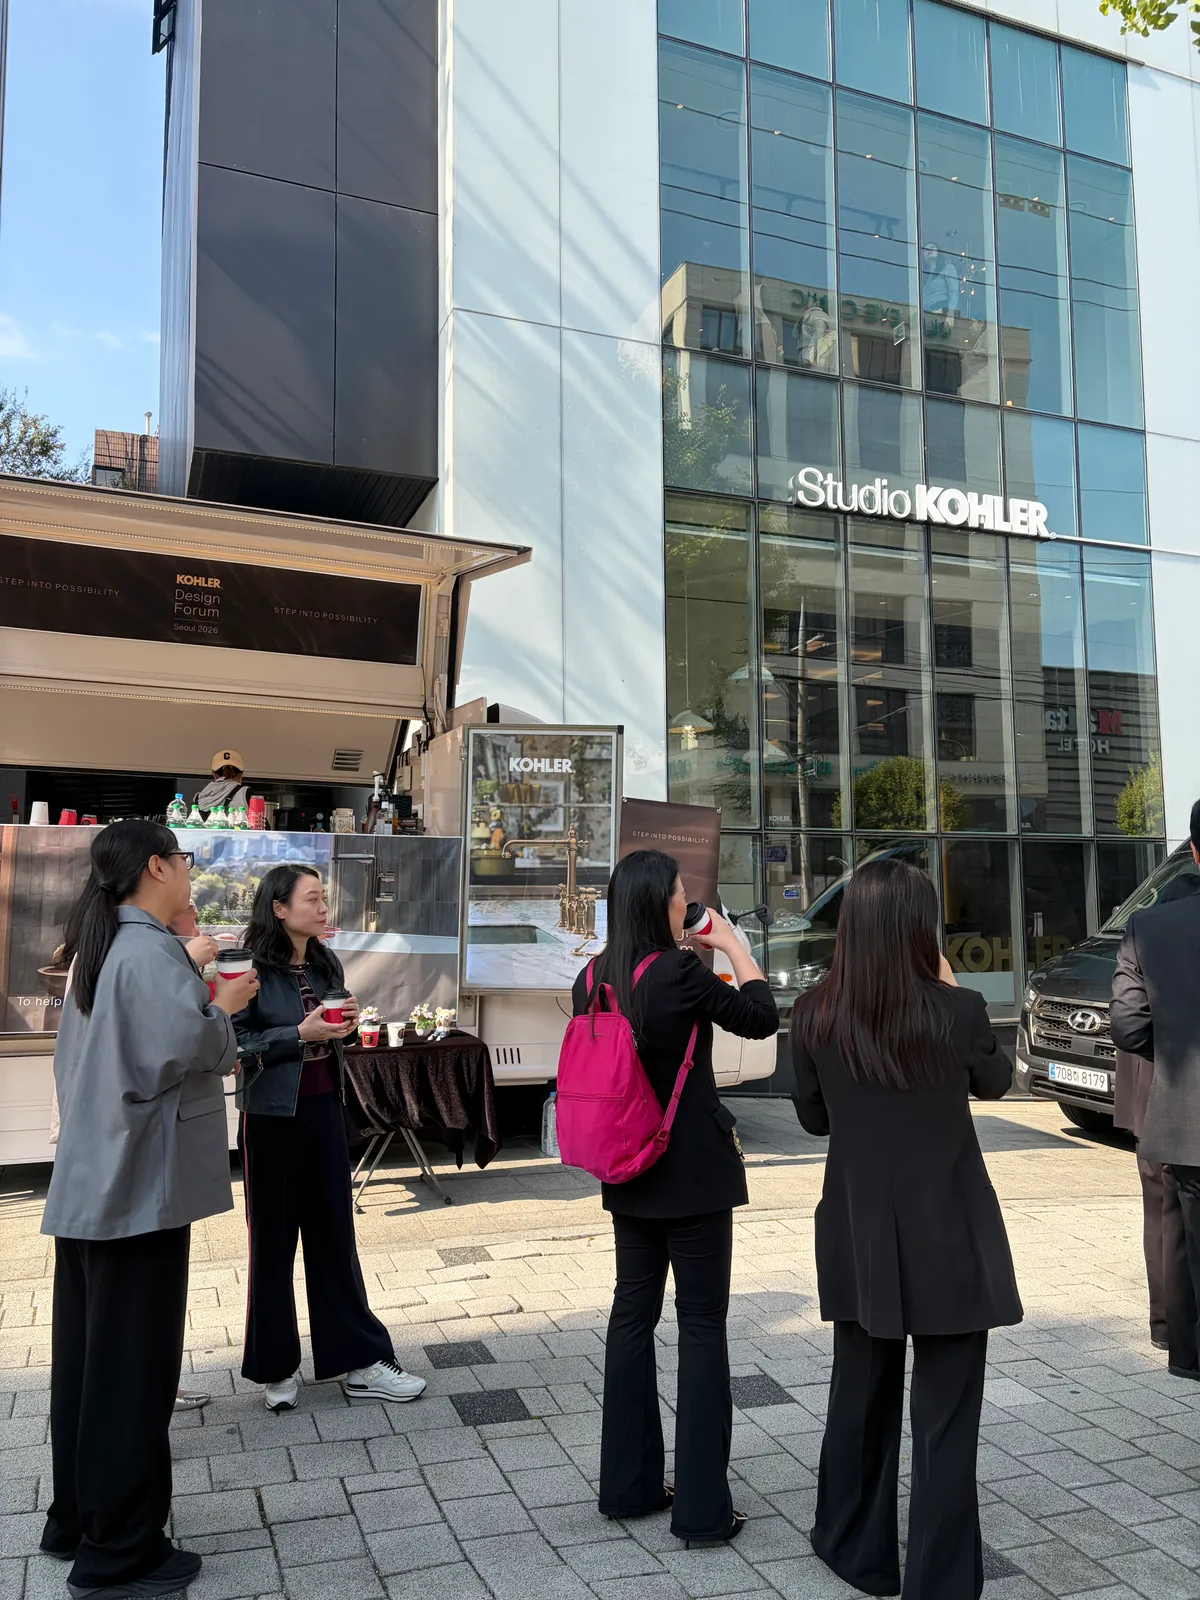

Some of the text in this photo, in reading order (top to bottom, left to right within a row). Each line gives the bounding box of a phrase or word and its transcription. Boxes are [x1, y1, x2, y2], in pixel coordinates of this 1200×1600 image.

[796, 466, 1051, 537] Studio KOHLER
[0, 576, 120, 597] STEP INTO POSSIBILITY
[176, 574, 222, 589] KOHLER
[174, 588, 221, 606] Design
[174, 602, 220, 618] Forum
[273, 606, 378, 624] STEP INTO POSSIBILITY
[173, 622, 219, 634] Seoul 2026
[223, 752, 231, 760] C
[509, 757, 573, 773] KOHLER
[632, 830, 649, 838] STEP
[667, 834, 709, 844] POSSIBILITY
[17, 996, 62, 1008] To help
[1081, 1071, 1105, 1088] 8179
